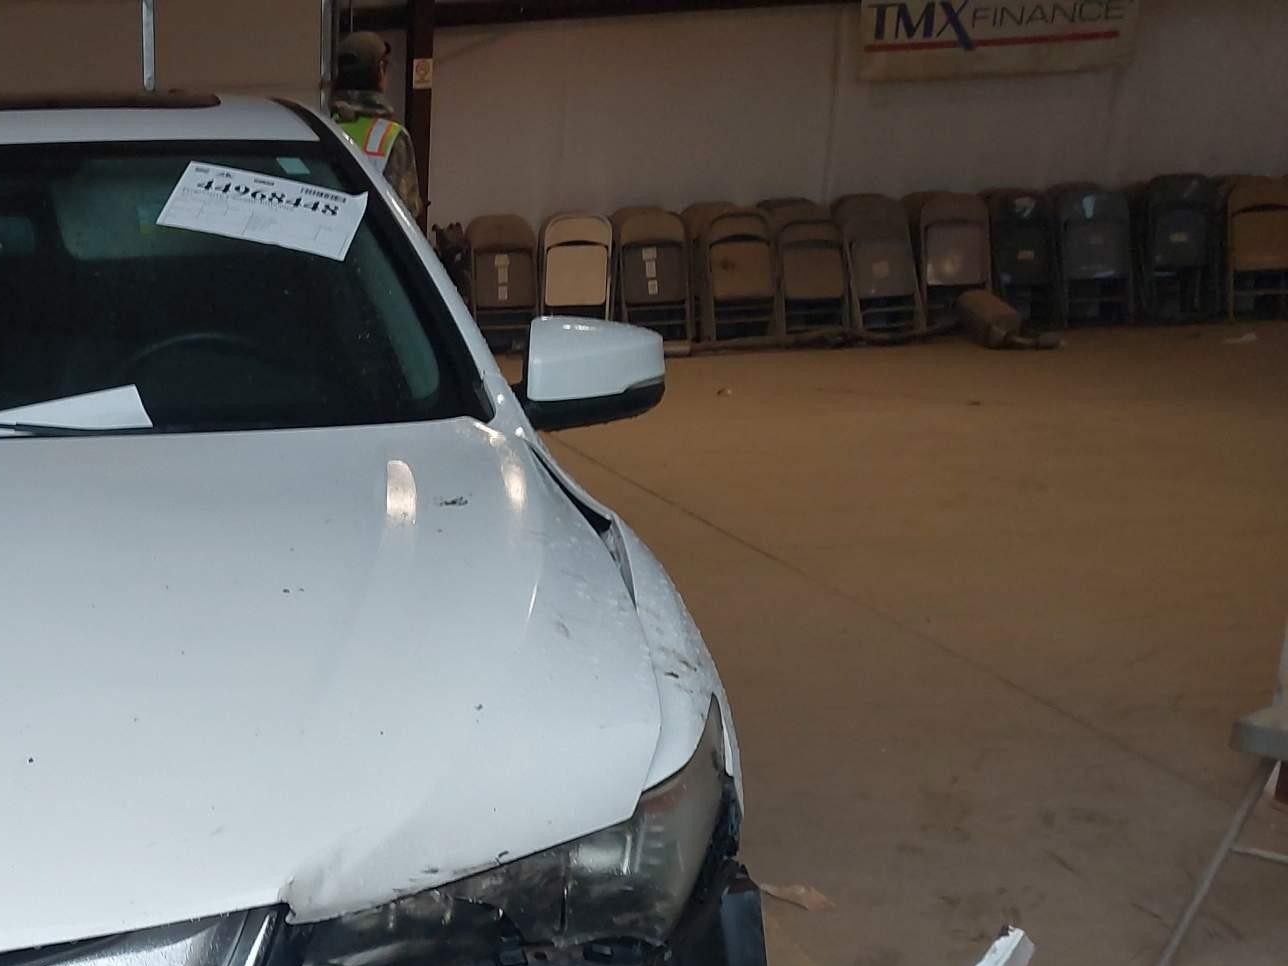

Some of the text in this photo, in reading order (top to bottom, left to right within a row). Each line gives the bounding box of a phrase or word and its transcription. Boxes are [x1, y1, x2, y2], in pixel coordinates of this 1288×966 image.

[868, 0, 1126, 50] TMX FINANCE
[197, 178, 340, 217] 44968448
